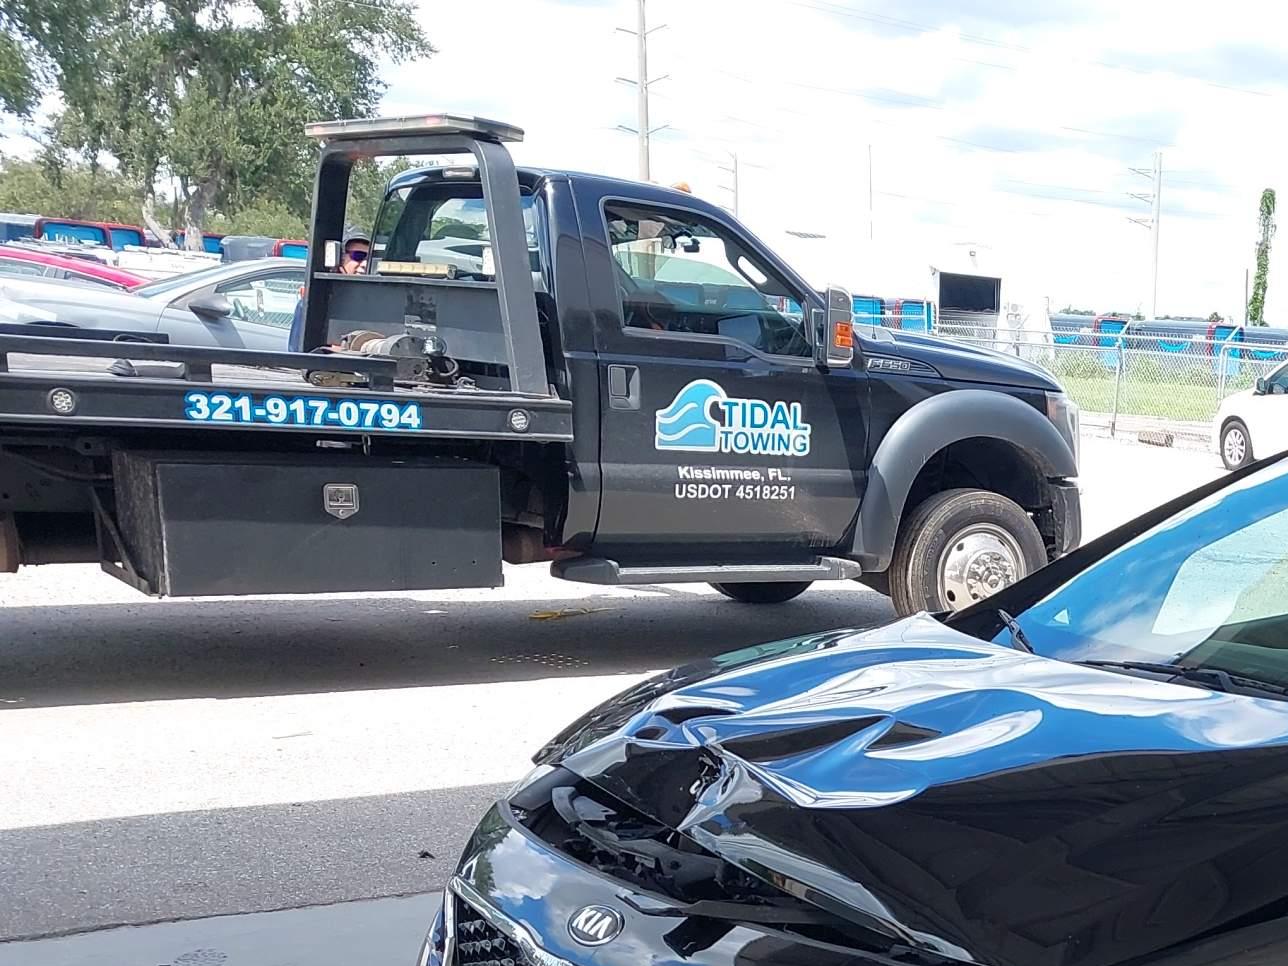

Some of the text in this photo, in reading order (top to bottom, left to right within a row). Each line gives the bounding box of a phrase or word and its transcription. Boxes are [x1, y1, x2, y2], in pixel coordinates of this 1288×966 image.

[187, 393, 421, 429] 321-917-0794
[720, 400, 809, 432] TIDAL
[719, 430, 808, 453] TOWING
[677, 466, 791, 482] Kissimmee, FL.
[675, 484, 795, 500] USDOT 4518251
[571, 908, 613, 940] KIA
